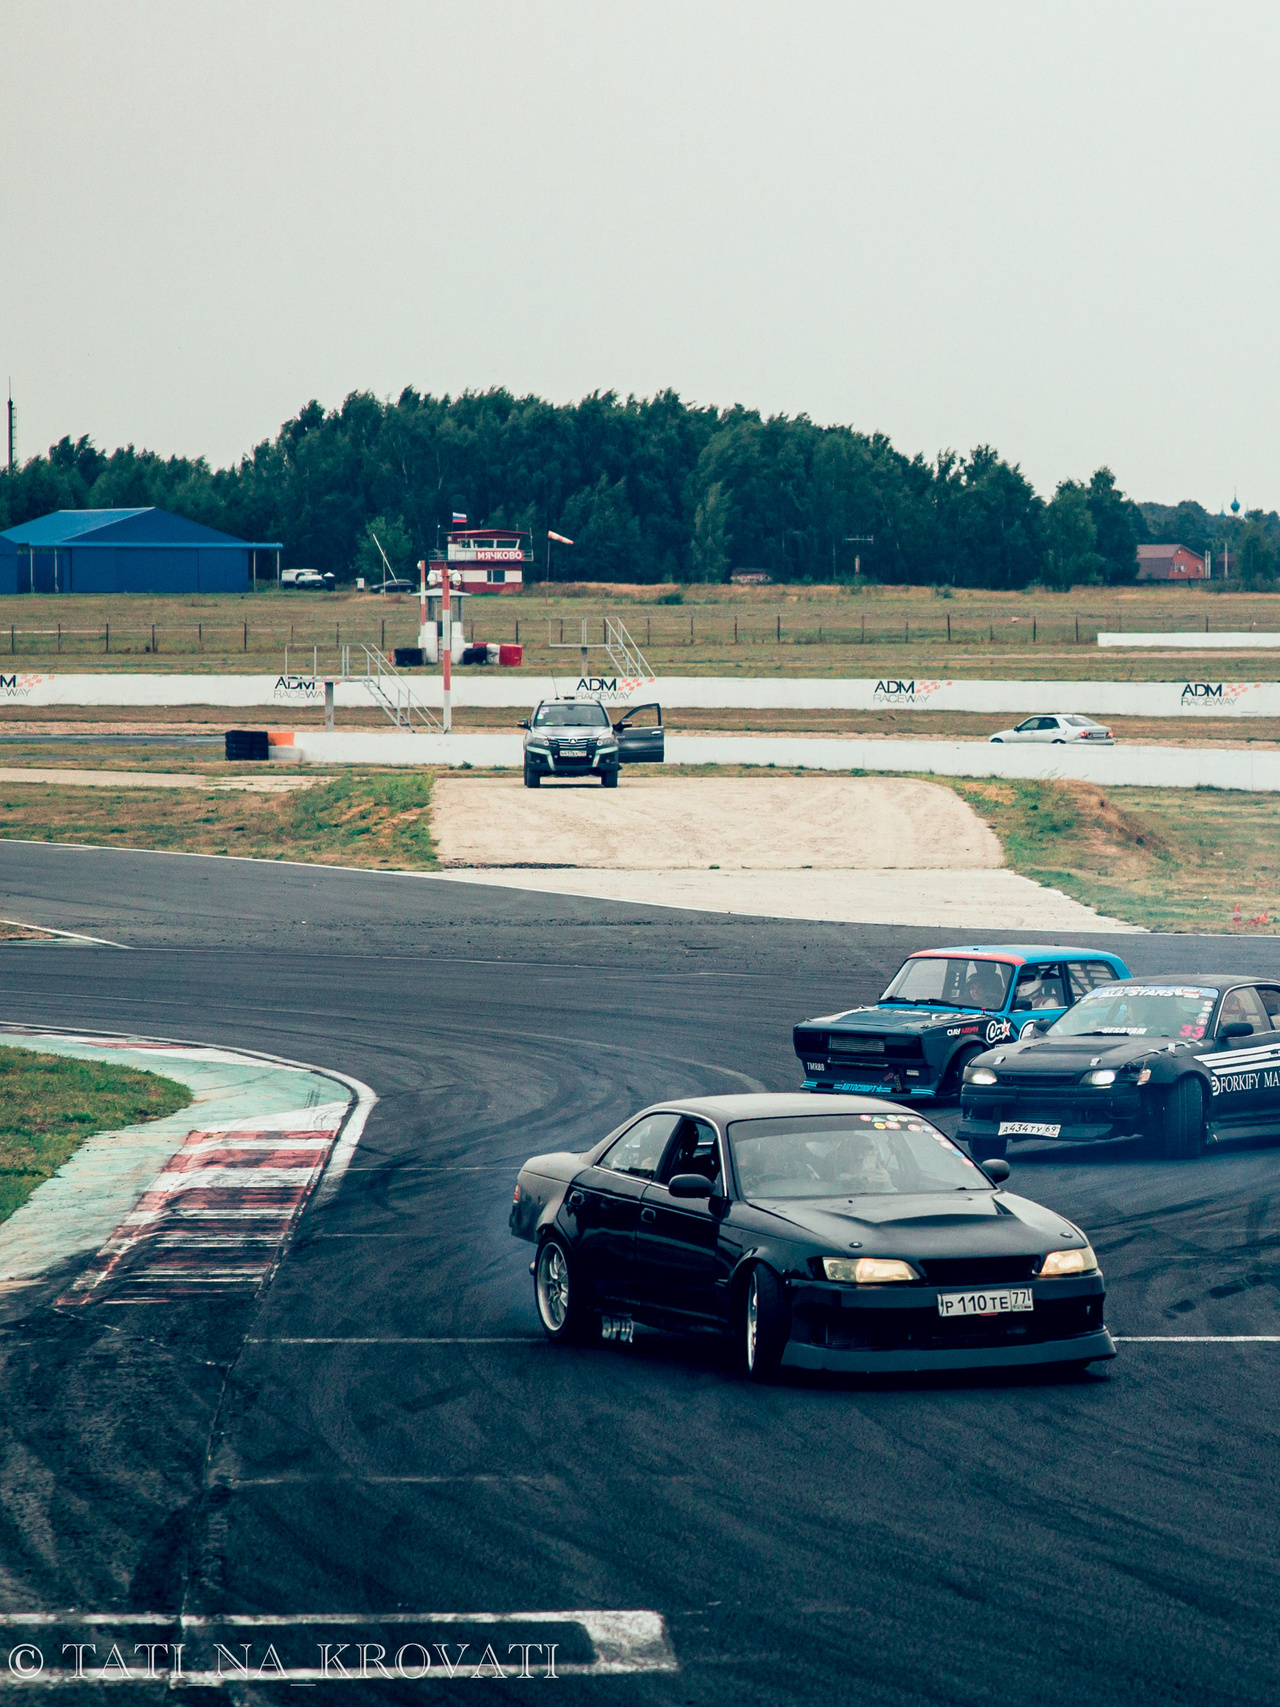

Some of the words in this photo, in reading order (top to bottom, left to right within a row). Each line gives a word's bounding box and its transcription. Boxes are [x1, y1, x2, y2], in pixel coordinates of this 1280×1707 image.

[477, 550, 523, 560] МЯЧКОВО
[274, 676, 316, 690] ADM
[576, 678, 617, 691] ADM
[874, 680, 915, 694] ADM
[575, 691, 632, 701] RACEWAY
[1181, 683, 1223, 697] ADM
[873, 694, 930, 703] RACEWAY
[1180, 697, 1238, 706] RACEWAY
[1127, 988, 1174, 997] STARS
[1179, 1024, 1206, 1039] 33
[1220, 1072, 1260, 1094] FORKIFY
